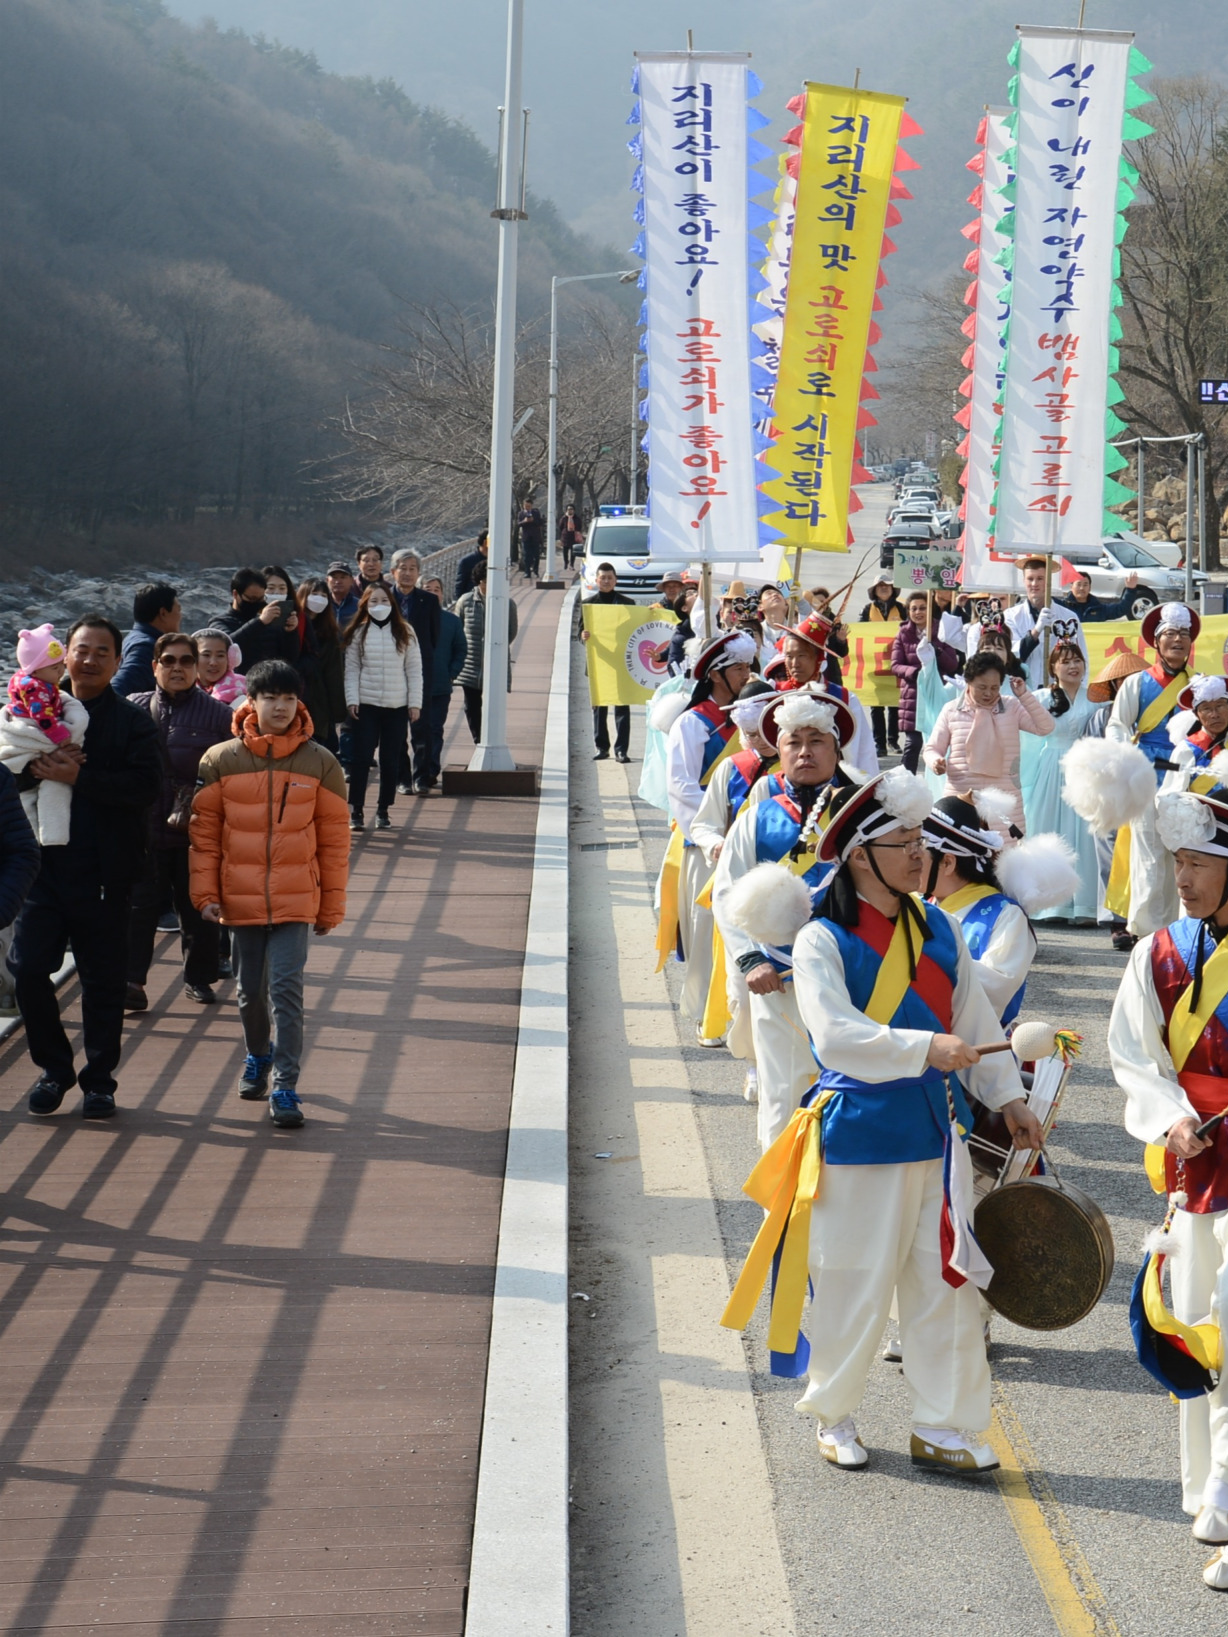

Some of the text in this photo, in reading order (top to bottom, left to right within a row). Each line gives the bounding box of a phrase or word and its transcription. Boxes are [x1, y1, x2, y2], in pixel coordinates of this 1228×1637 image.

[1049, 63, 1095, 116] 신이
[672, 83, 728, 529] 지리산이 좋아요! 고로쇠가 좋아요!
[1040, 207, 1088, 323] 자연약수
[784, 114, 870, 527] 지리산의 맛 고로쇠로 시작된다
[1032, 333, 1080, 422] 뱀사골
[1026, 435, 1073, 517] 고로쇠
[646, 622, 663, 630] LOVE
